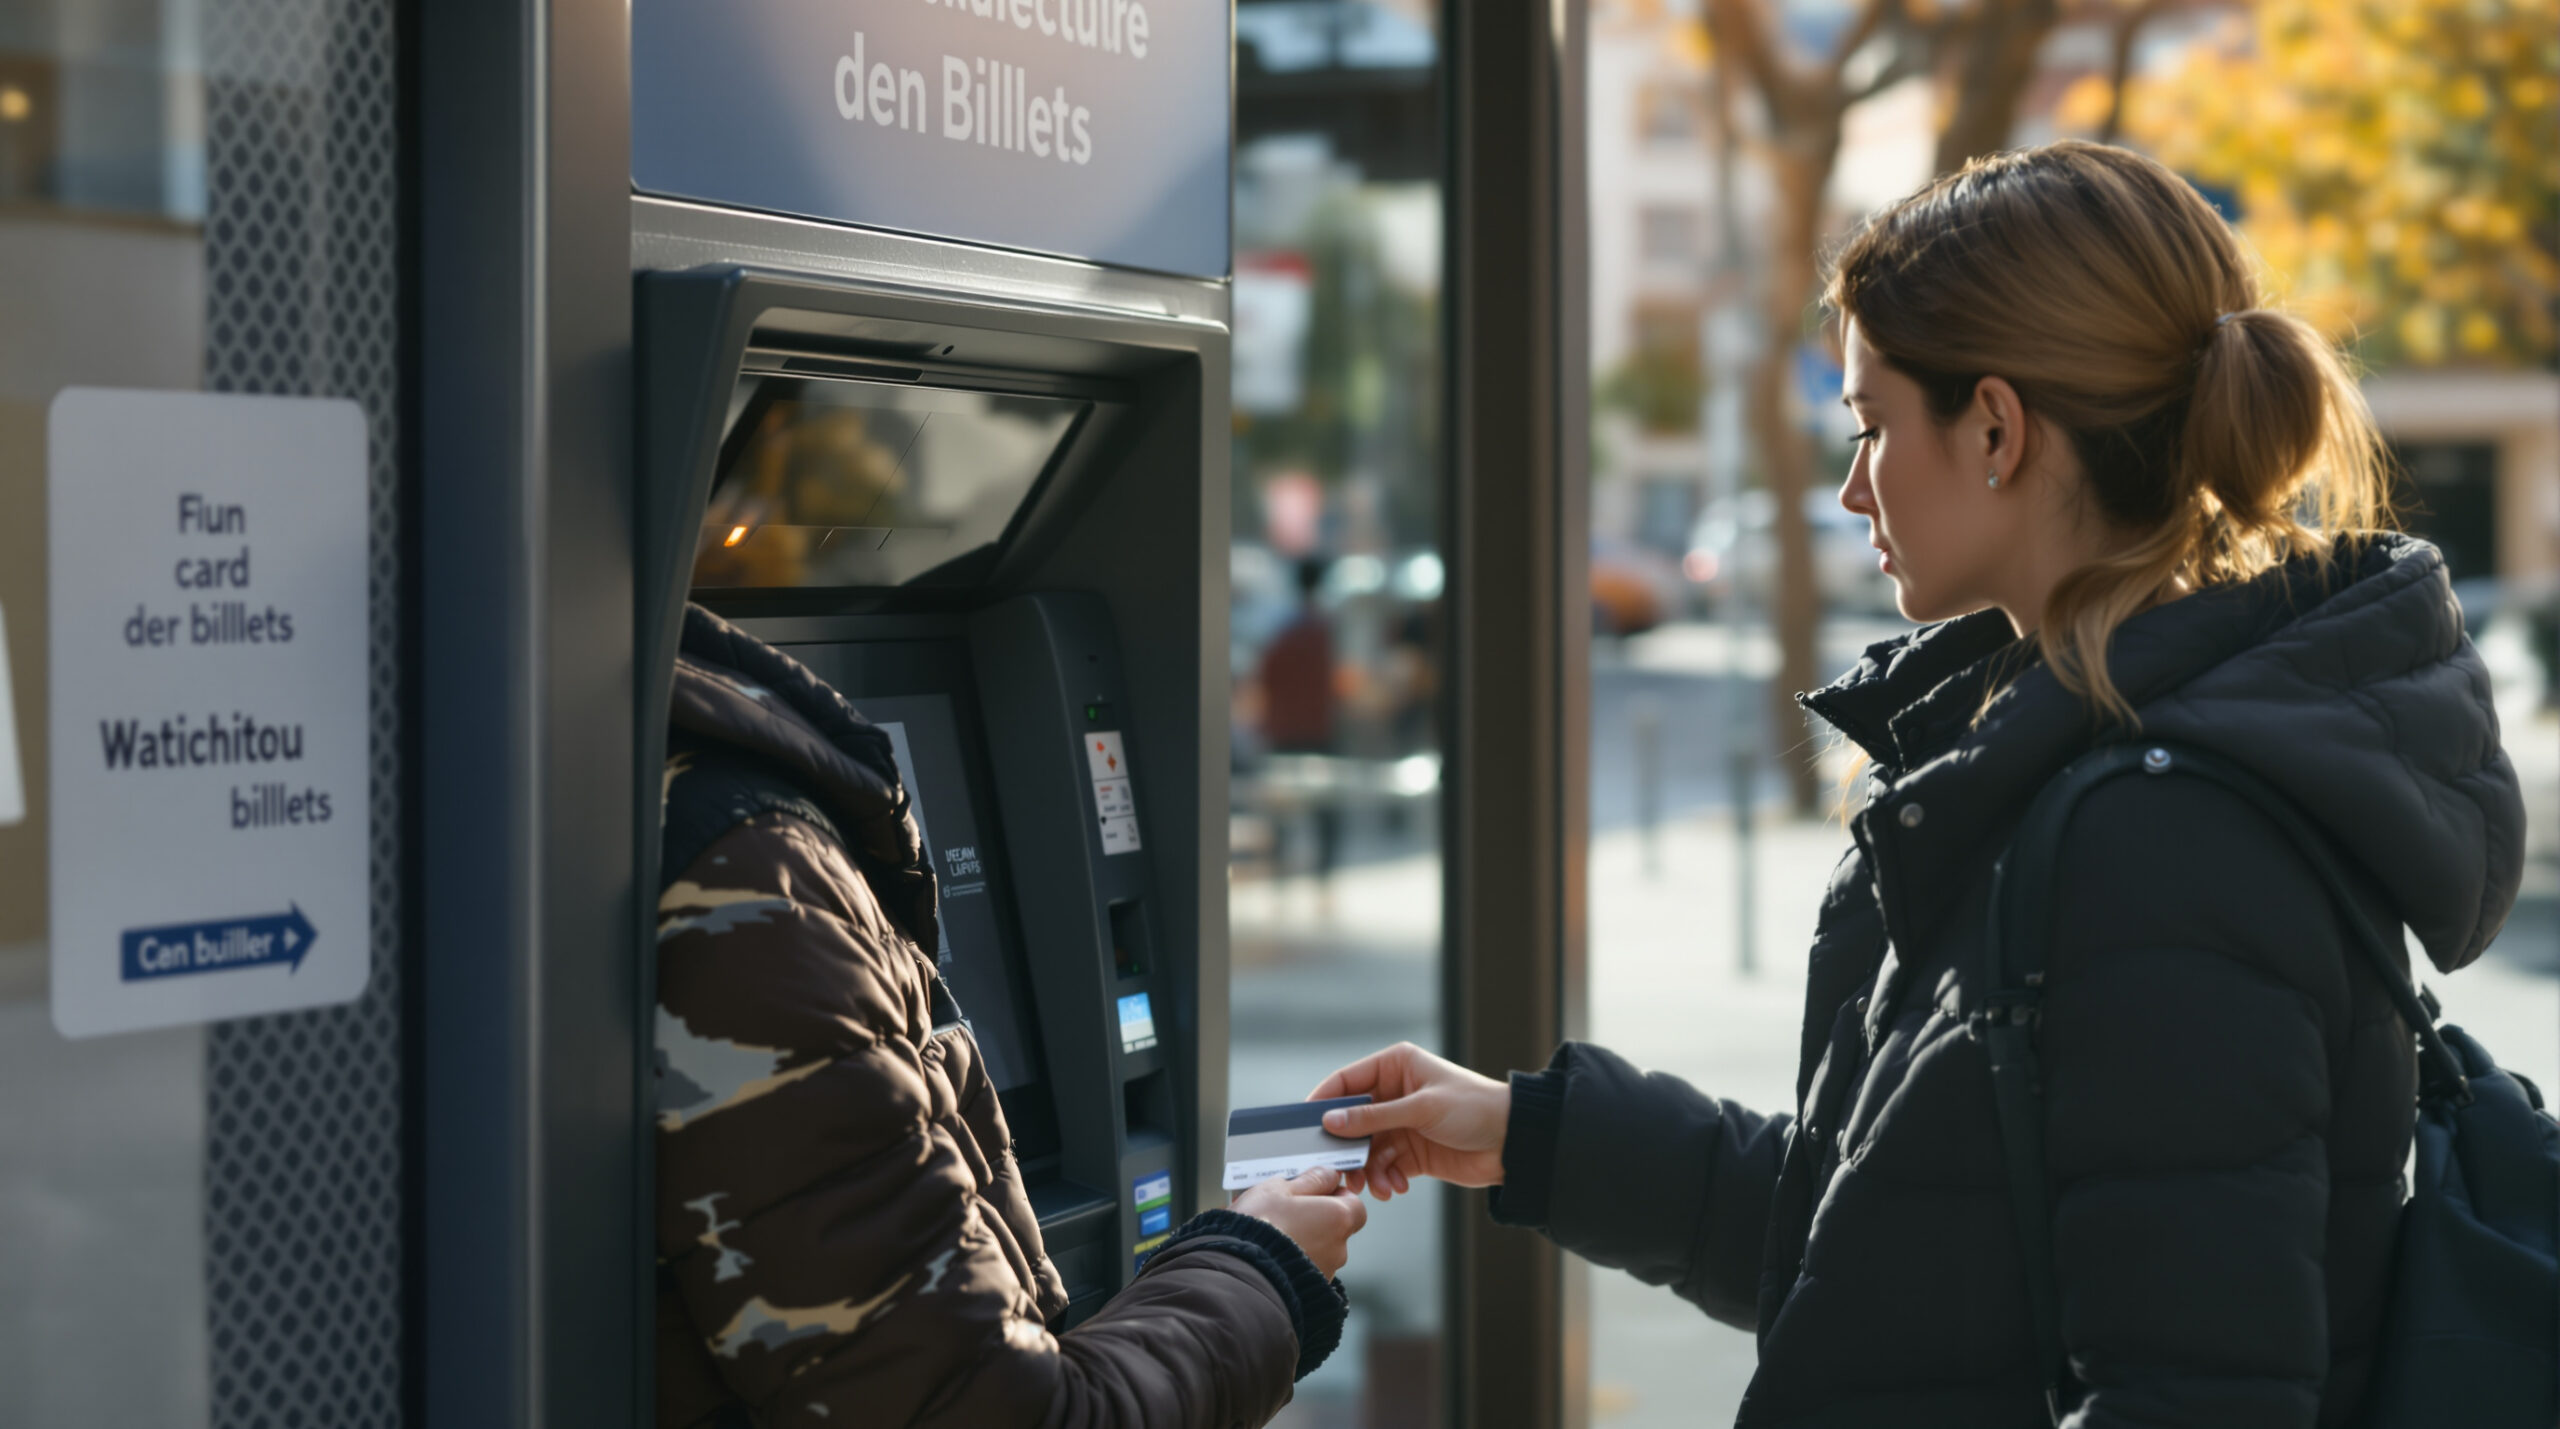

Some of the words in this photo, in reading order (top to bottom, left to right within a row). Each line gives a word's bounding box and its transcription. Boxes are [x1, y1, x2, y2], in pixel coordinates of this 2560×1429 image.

[834, 31, 927, 134] den
[942, 54, 1092, 165] Billlets
[174, 545, 250, 590] card
[124, 605, 181, 647] der
[100, 710, 304, 770] Watichitou
